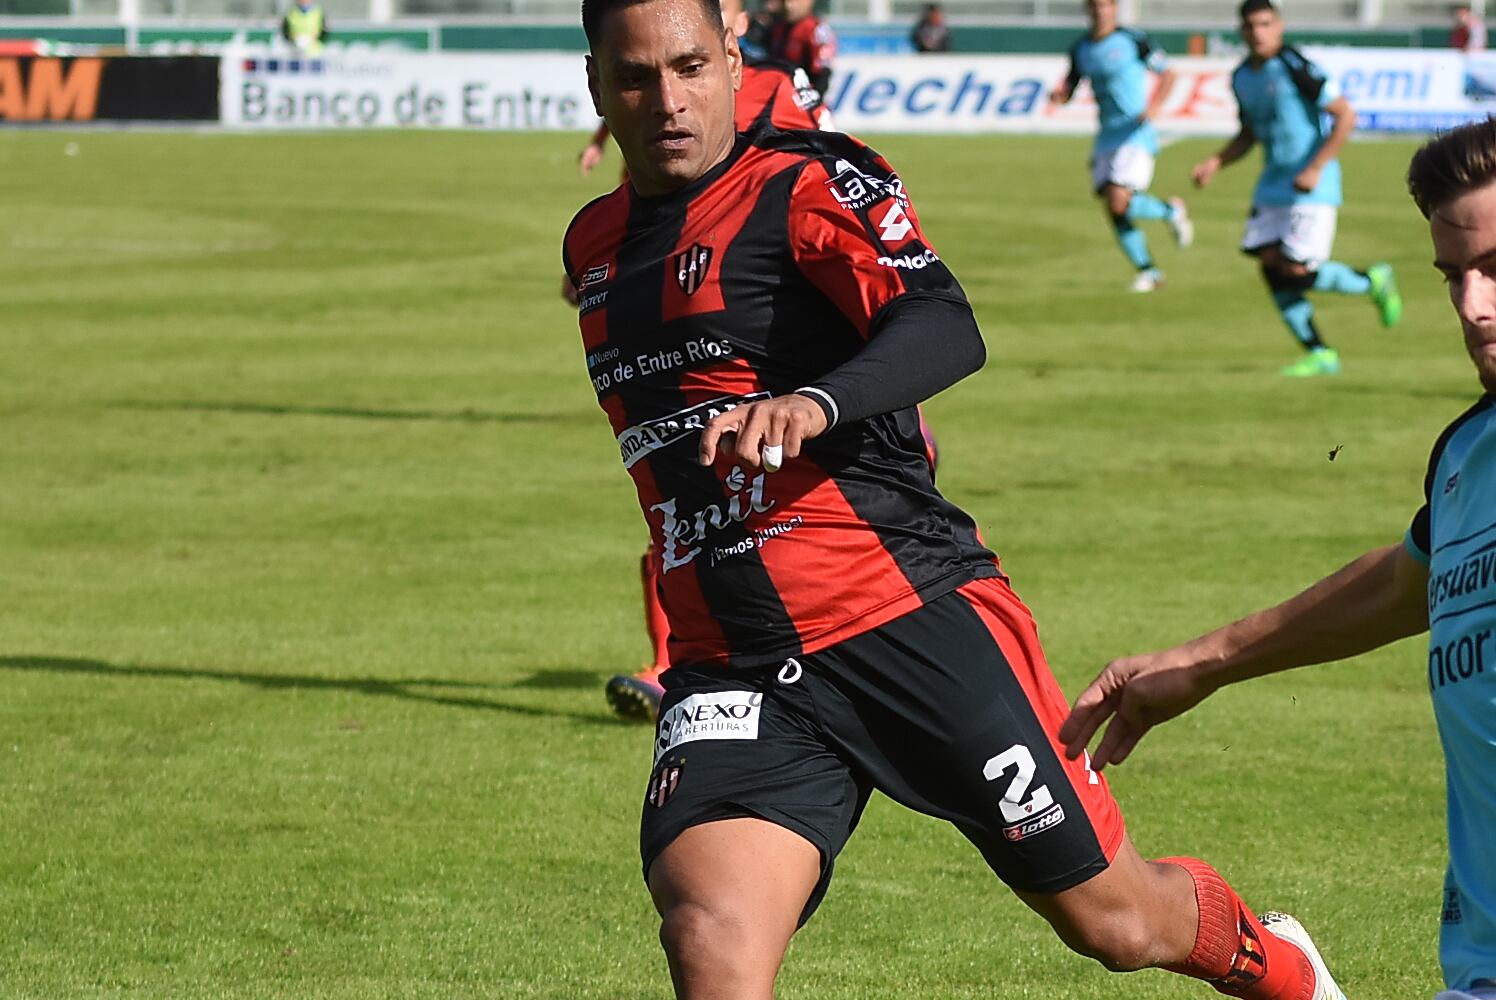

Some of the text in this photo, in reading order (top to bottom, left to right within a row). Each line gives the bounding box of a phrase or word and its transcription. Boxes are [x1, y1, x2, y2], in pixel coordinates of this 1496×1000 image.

[241, 82, 579, 127] Banco de Entre
[594, 347, 619, 364] Nuevo
[613, 362, 634, 383] de
[636, 350, 684, 376] Entre
[685, 337, 733, 362] Ríos
[678, 722, 749, 737] ABERTURAS
[681, 703, 752, 725] NEXO
[982, 744, 1054, 823] 2
